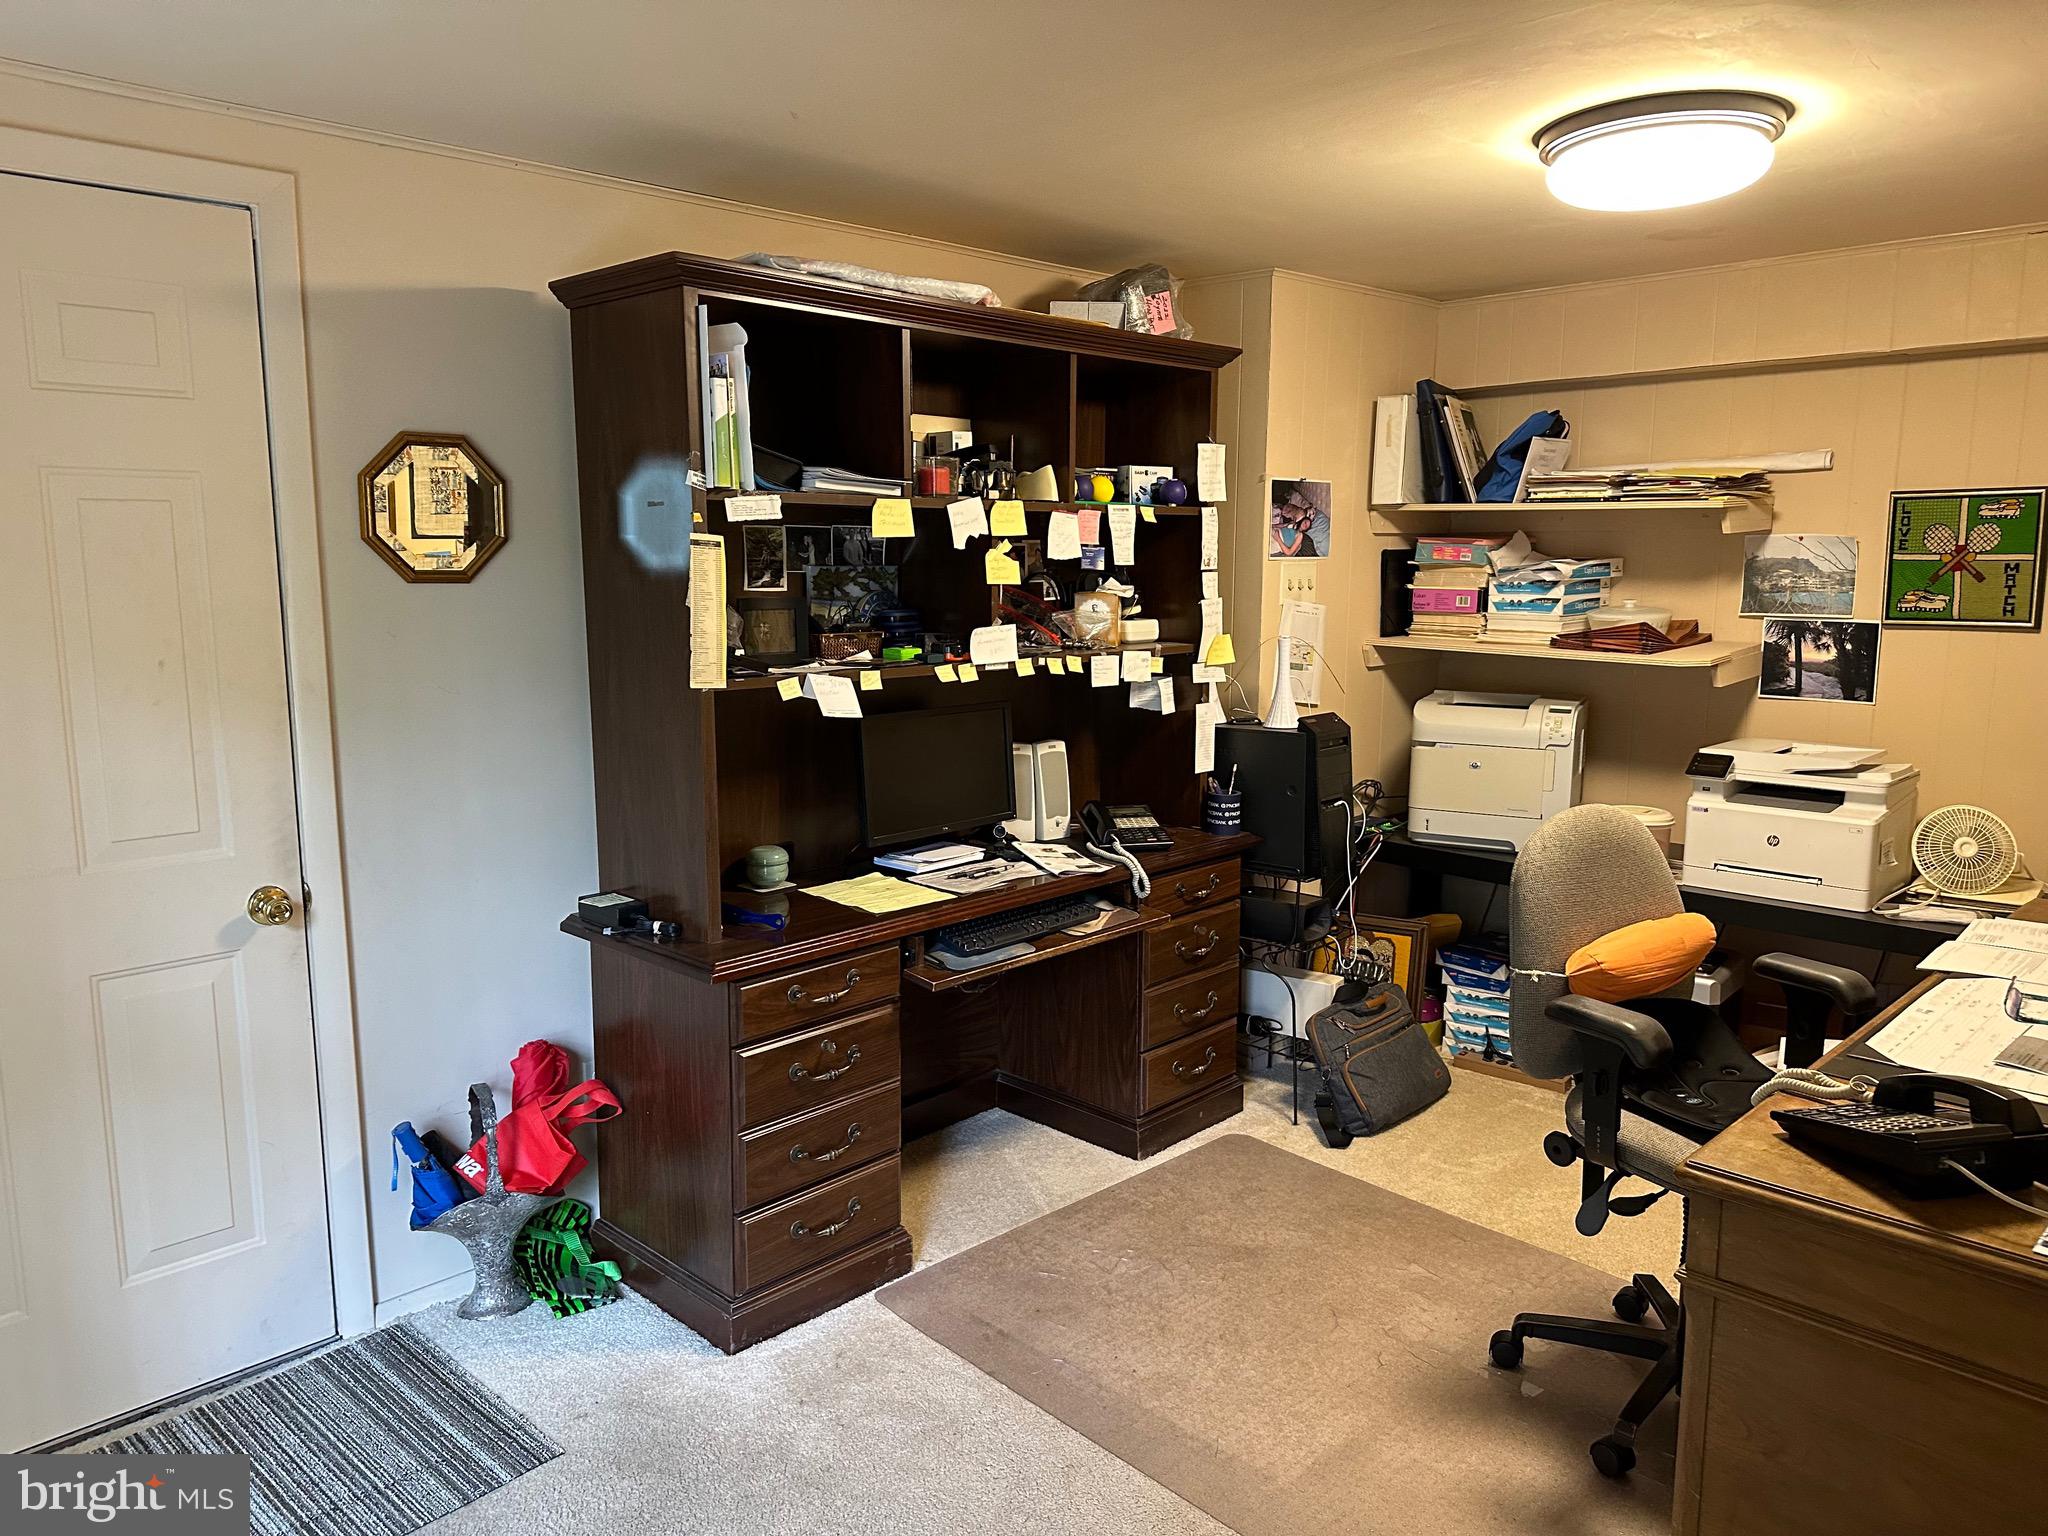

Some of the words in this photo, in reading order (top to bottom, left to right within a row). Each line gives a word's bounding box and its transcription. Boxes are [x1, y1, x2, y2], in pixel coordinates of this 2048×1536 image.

[1898, 503, 1912, 550] LOVE
[2002, 562, 2020, 617] MATCH
[1768, 835, 1779, 847] hp
